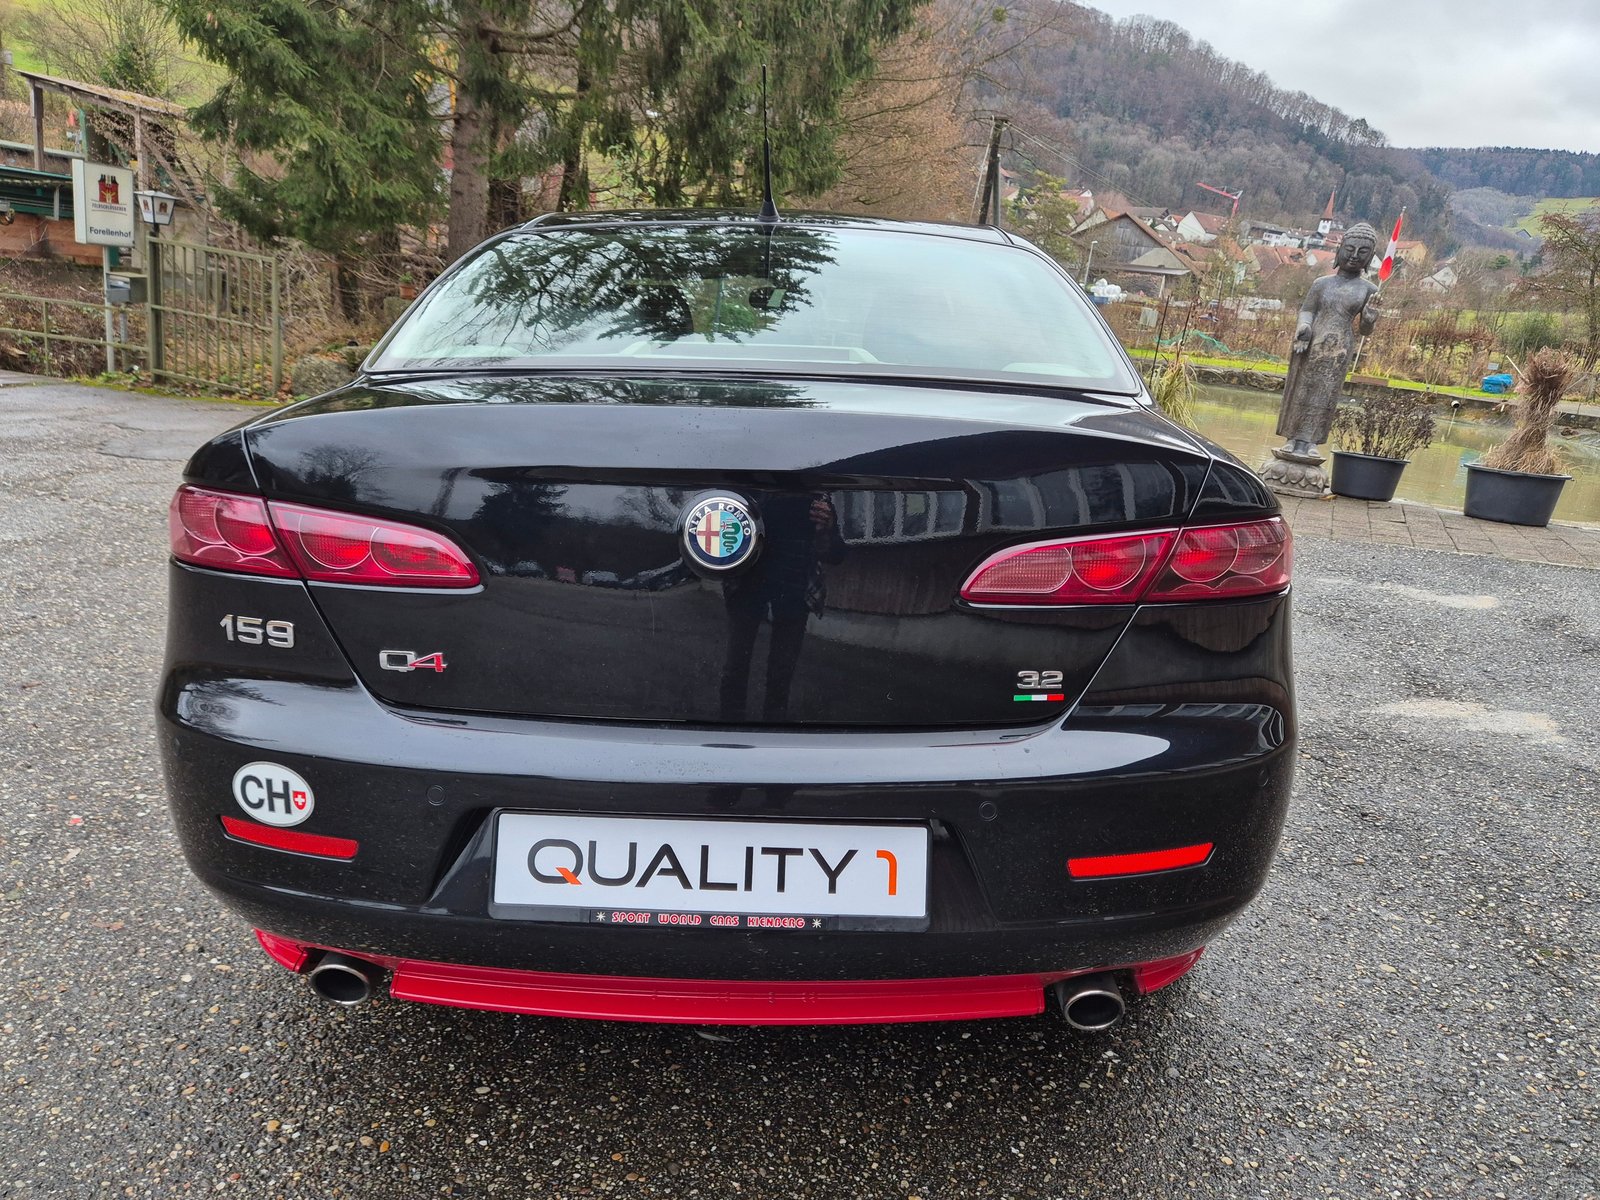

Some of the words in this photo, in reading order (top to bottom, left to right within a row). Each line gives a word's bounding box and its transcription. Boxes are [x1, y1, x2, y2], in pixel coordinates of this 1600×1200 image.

[89, 226, 132, 238] Forellenhof
[689, 505, 712, 535] ALFA
[718, 503, 751, 536] ROMEO
[219, 614, 295, 649] 159
[379, 650, 447, 672] Q4
[240, 774, 293, 815] CH
[527, 838, 859, 895] QUALITY
[876, 849, 898, 896] 1
[611, 911, 651, 924] SPORT
[658, 913, 702, 926] WORLD
[709, 915, 740, 927] CARS
[747, 916, 806, 929] KIENBERG
